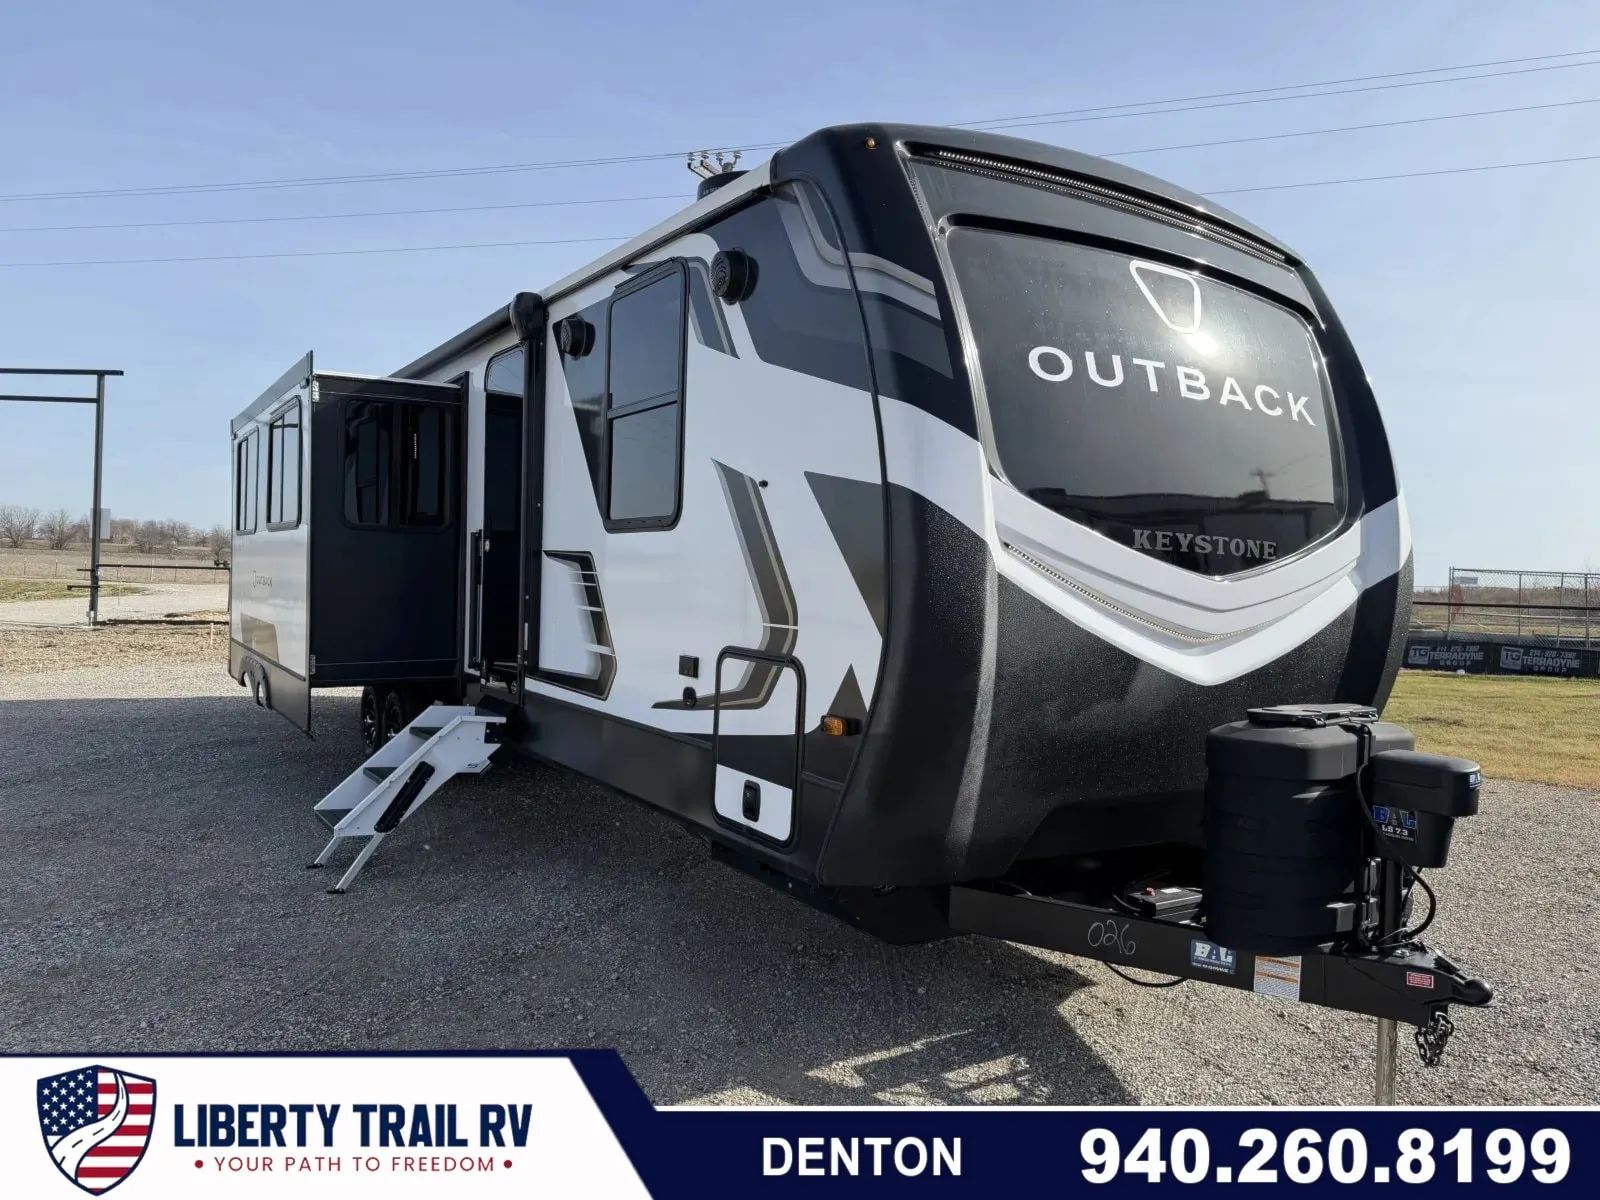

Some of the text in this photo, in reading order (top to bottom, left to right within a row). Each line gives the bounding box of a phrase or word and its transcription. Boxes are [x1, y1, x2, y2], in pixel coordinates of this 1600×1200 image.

[1028, 345, 1316, 426] OUTBACK
[1132, 528, 1277, 560] KEYSTONE
[1429, 651, 1485, 660] TERRADYNE
[1522, 655, 1580, 668] TERRADYNE
[1087, 919, 1136, 956] 026
